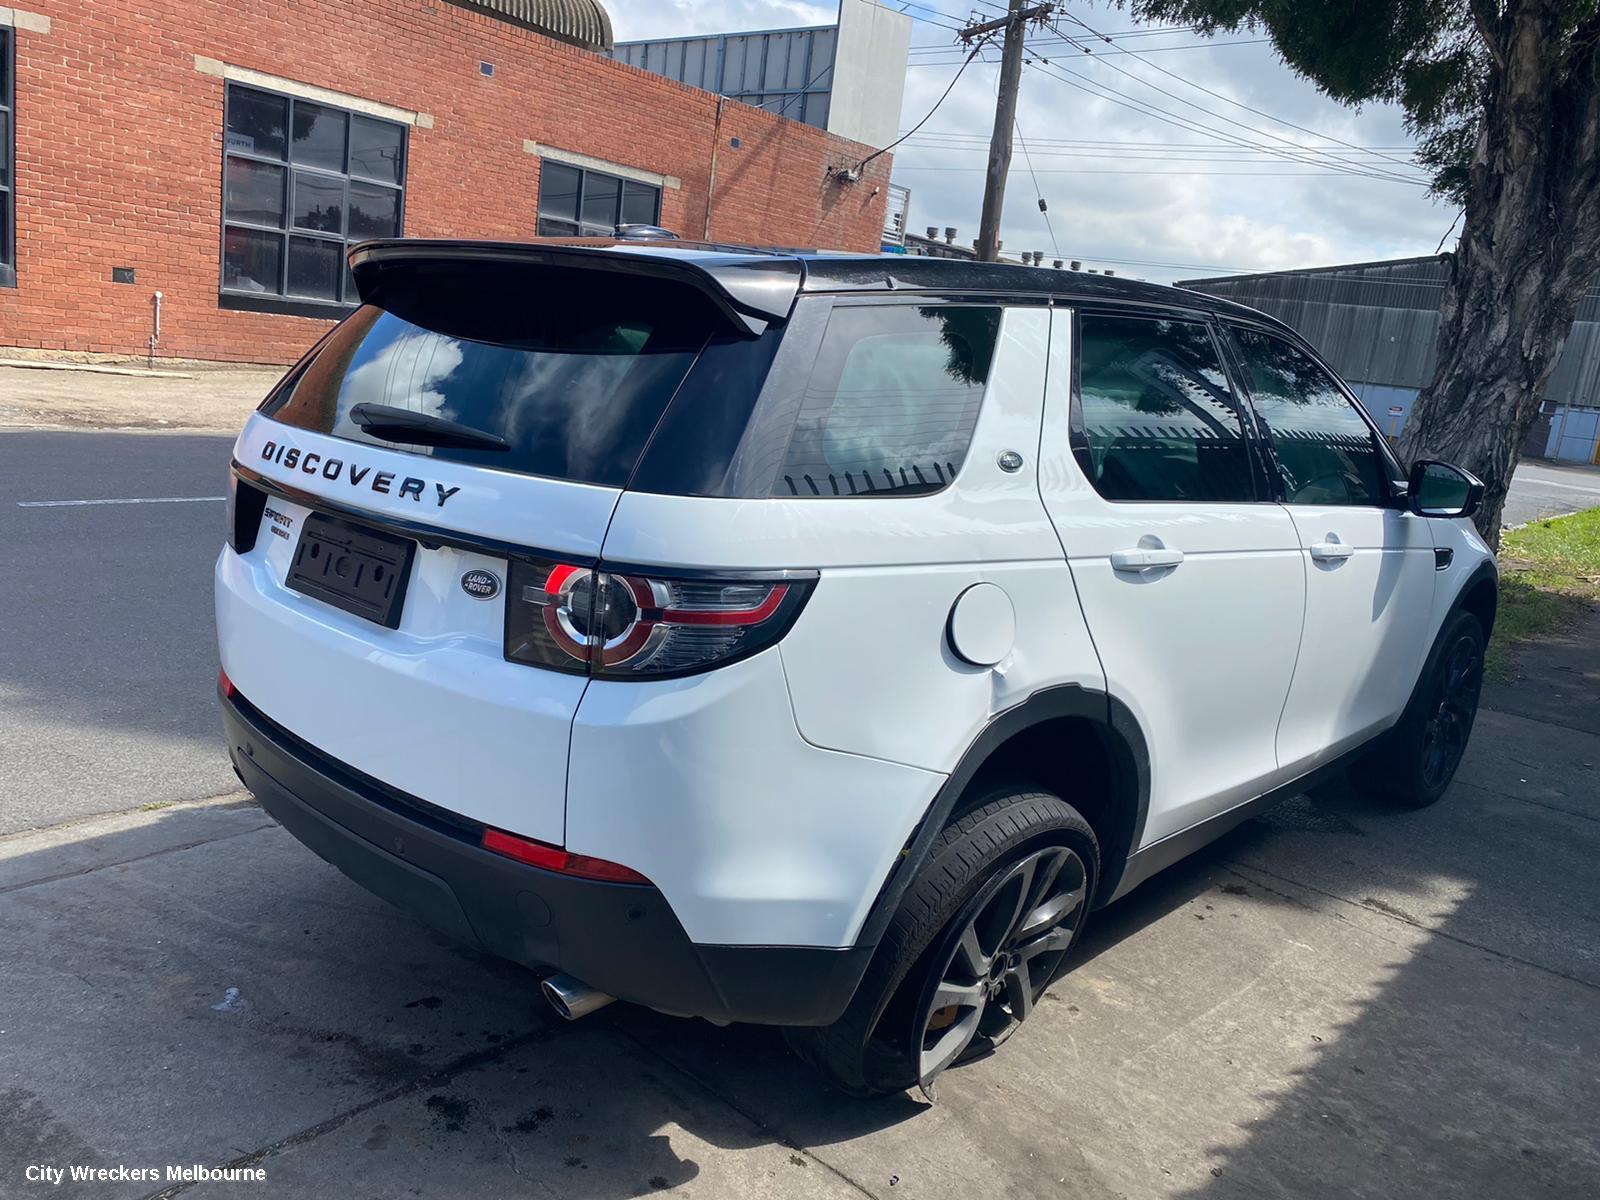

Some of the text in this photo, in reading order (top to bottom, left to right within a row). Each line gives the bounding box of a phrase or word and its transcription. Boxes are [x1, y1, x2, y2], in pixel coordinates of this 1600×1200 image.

[261, 441, 460, 507] DISCOVERY
[467, 574, 487, 585] LAND
[467, 582, 492, 594] ROVER
